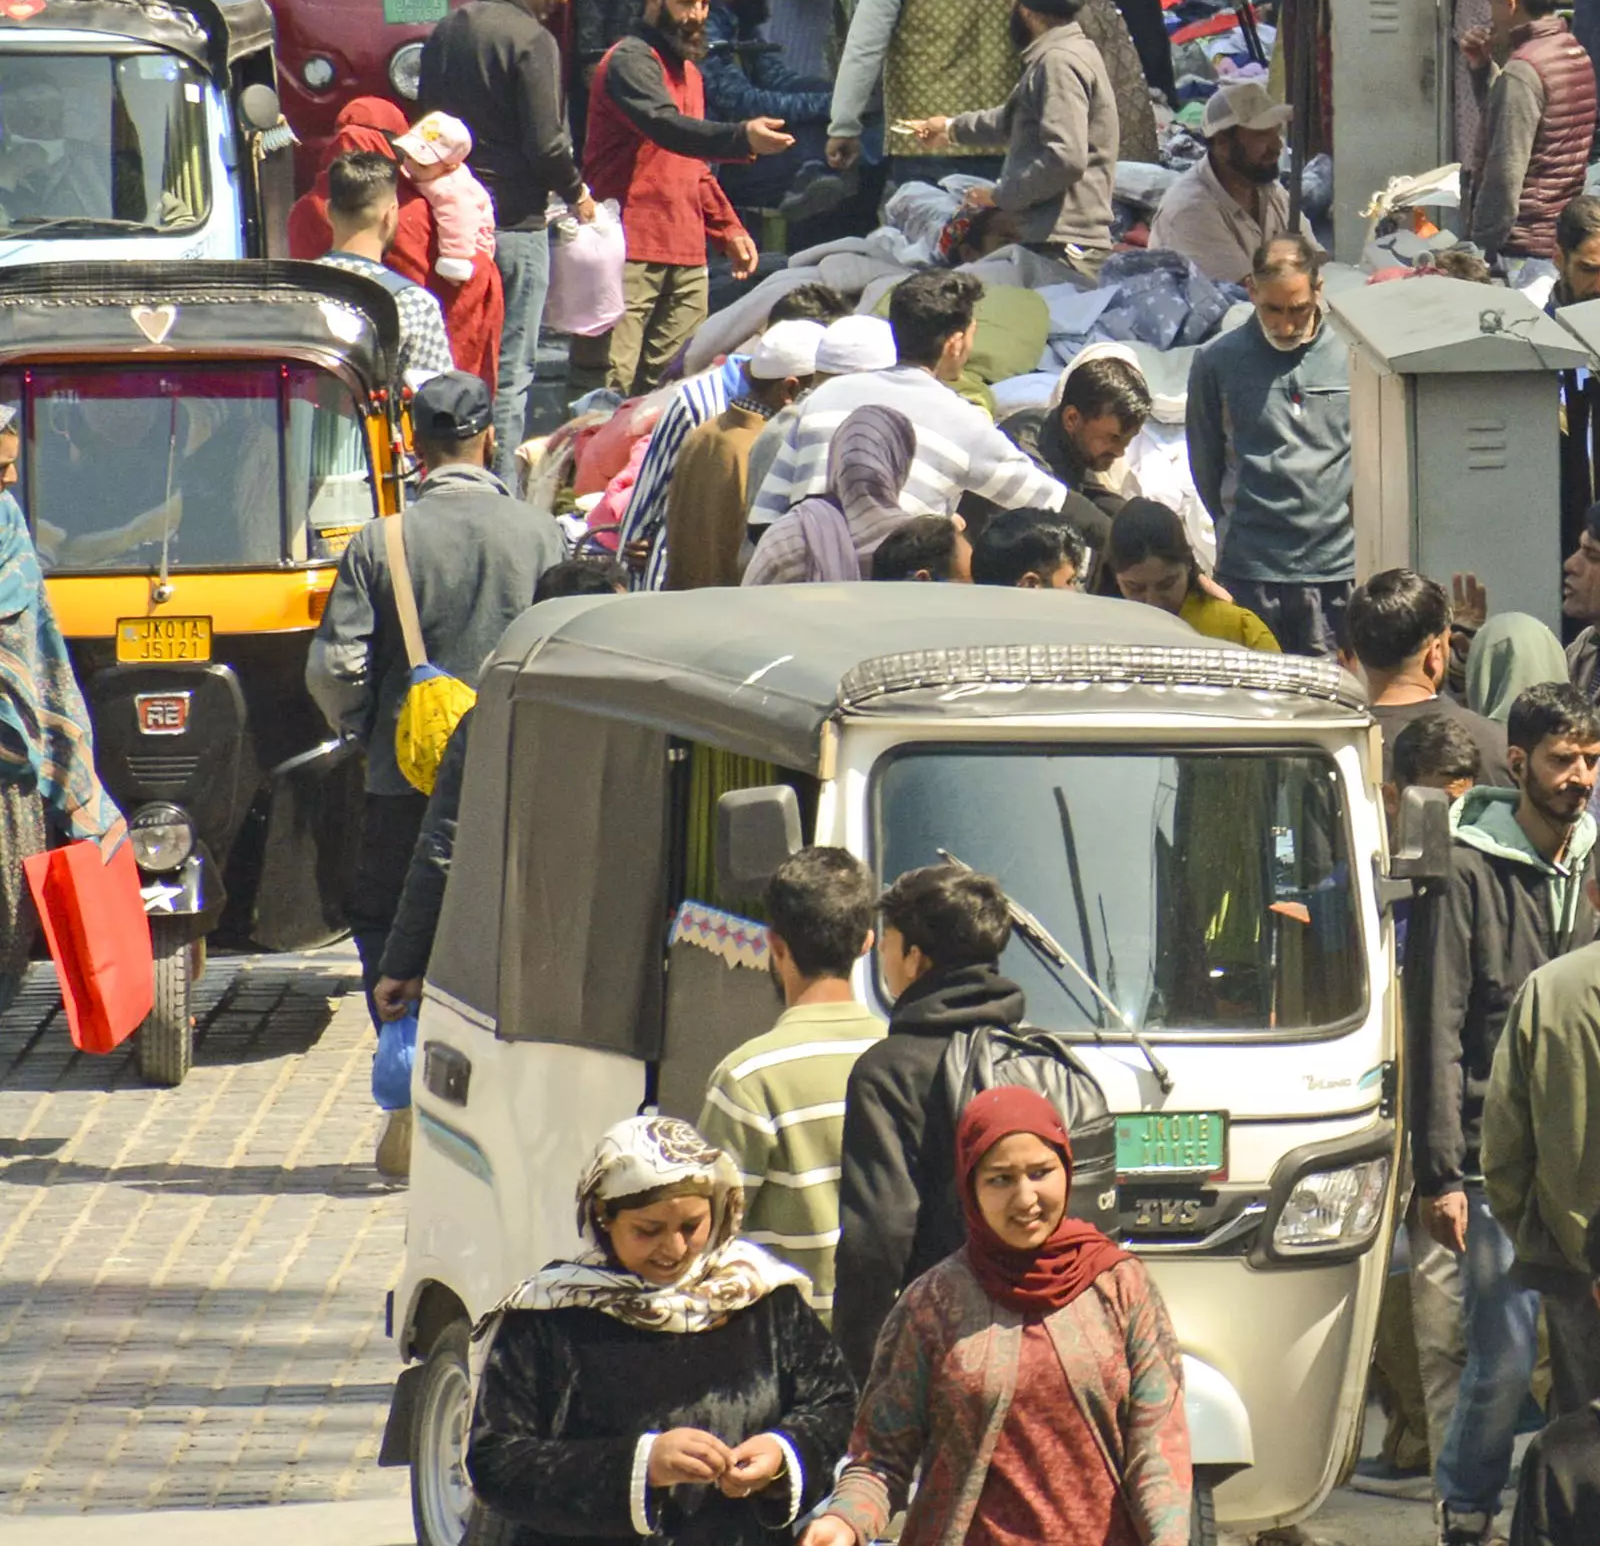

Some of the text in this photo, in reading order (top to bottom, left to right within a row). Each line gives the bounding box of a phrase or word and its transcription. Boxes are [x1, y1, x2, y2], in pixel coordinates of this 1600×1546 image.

[141, 621, 201, 639] JK01A
[141, 641, 199, 659] J5121
[147, 706, 181, 725] RE
[1135, 1199, 1201, 1225] TVS
